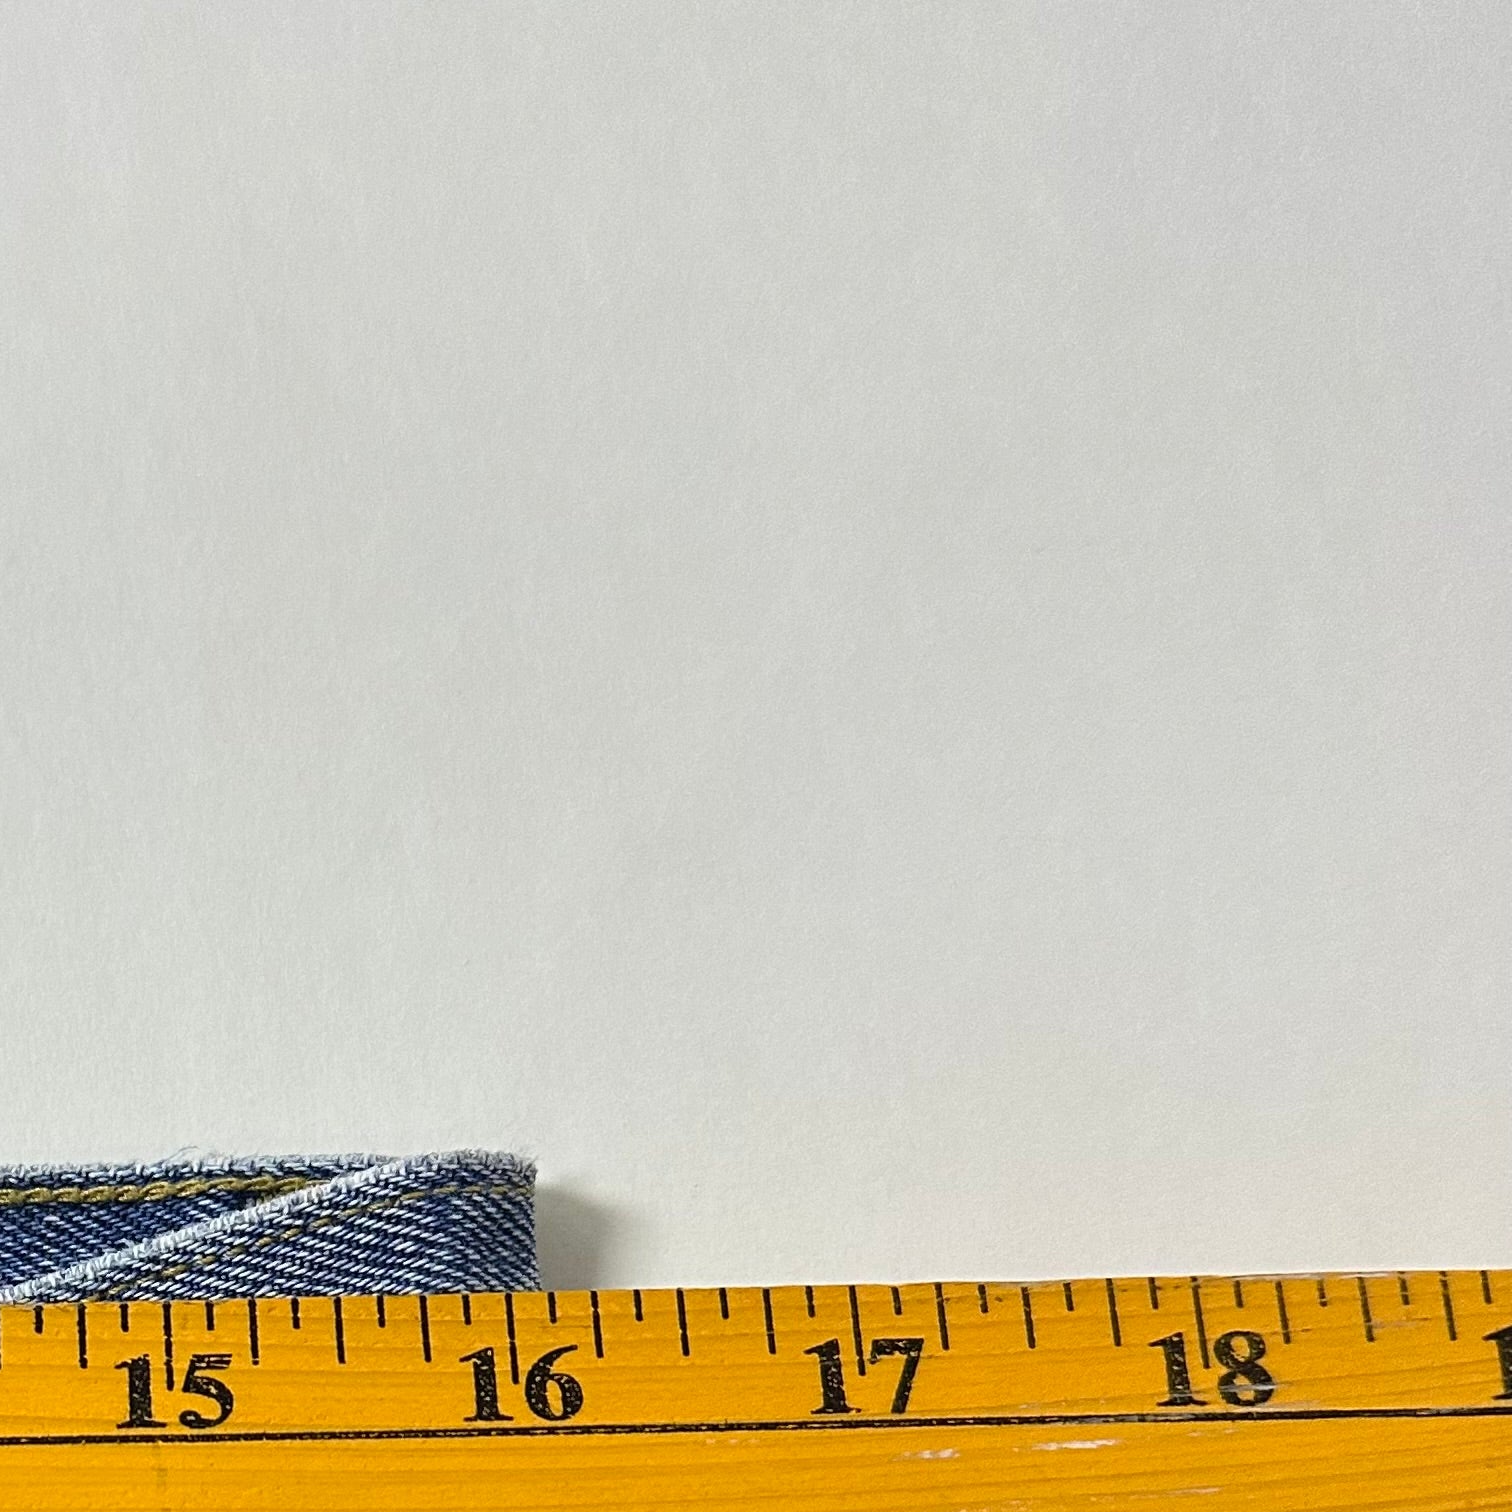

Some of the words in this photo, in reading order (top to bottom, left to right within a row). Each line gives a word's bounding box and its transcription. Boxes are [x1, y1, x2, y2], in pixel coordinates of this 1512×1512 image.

[114, 1354, 233, 1429] 15
[459, 1345, 584, 1422] 16
[804, 1338, 924, 1414] 17
[1148, 1331, 1276, 1407] 18
